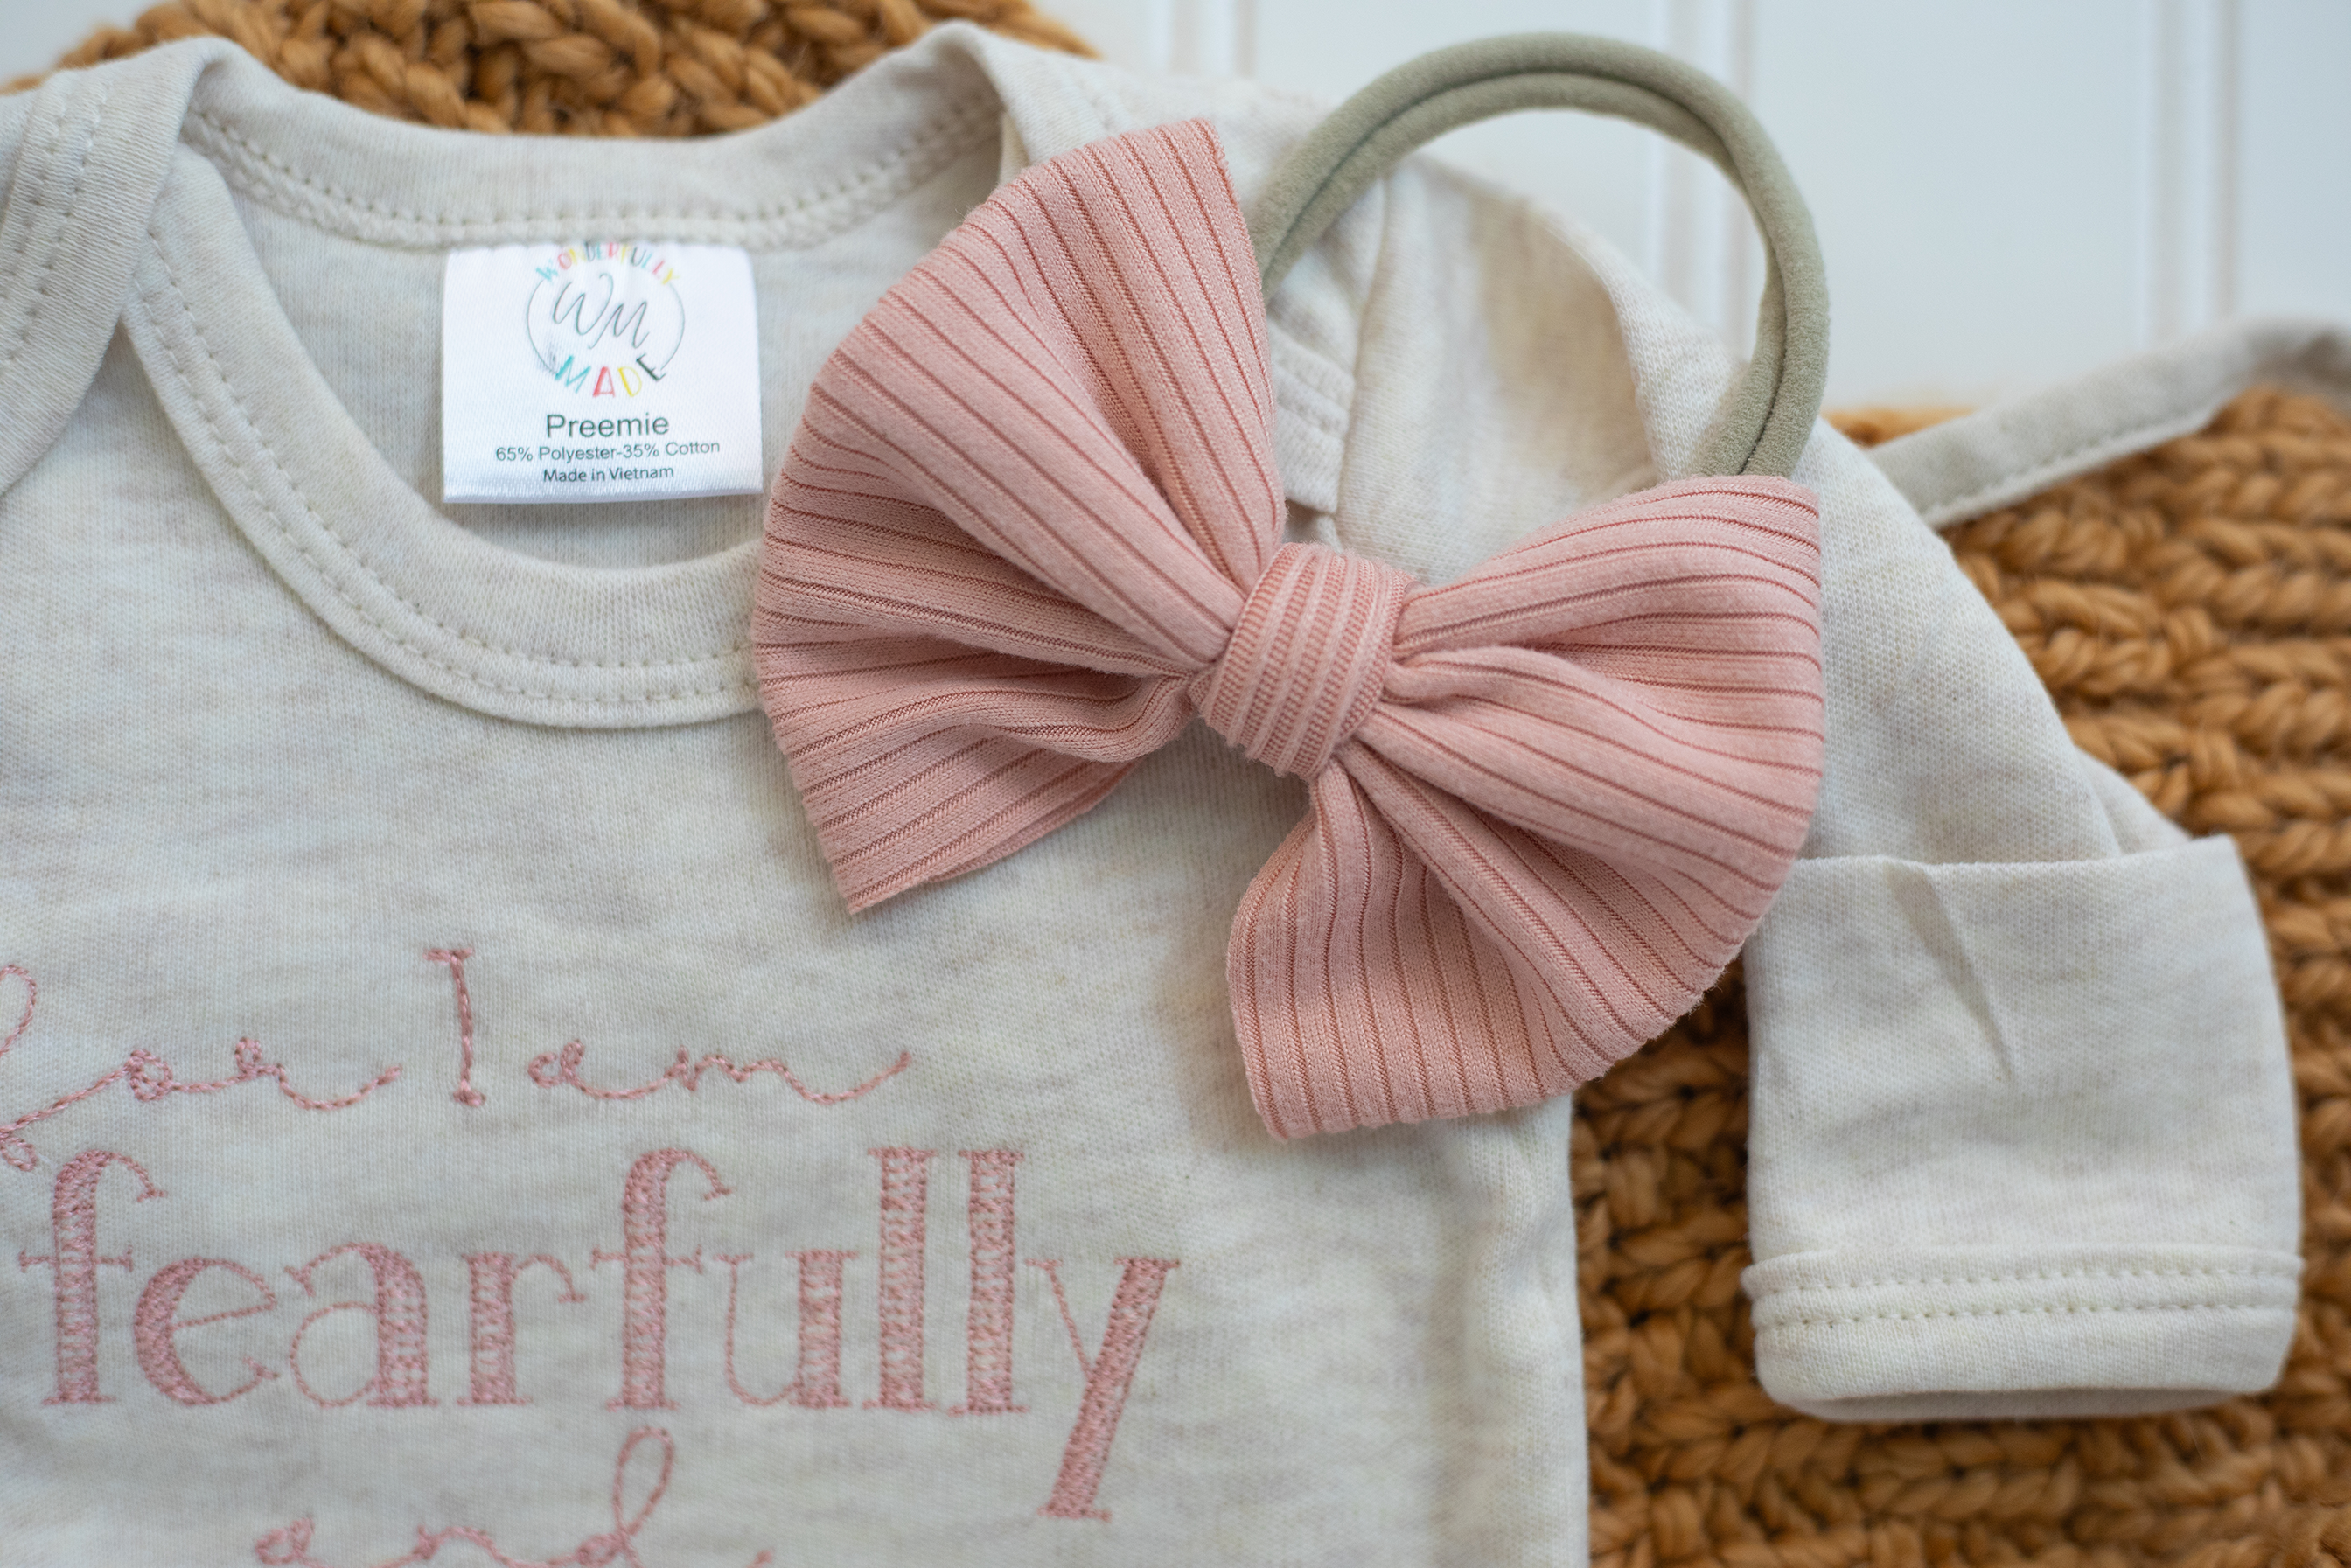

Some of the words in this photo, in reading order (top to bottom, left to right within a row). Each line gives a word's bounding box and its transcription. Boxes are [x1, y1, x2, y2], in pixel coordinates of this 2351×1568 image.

[554, 353, 666, 398] MADE
[546, 412, 670, 438] Preemie
[495, 447, 534, 462] 65%
[539, 443, 660, 463] Polyester-35%
[665, 441, 721, 456] Cotton
[543, 468, 587, 482] Made
[591, 468, 606, 481] in
[609, 466, 674, 481] Vietnam
[528, 1040, 912, 1105] am
[19, 1146, 1180, 1522] fearfully
